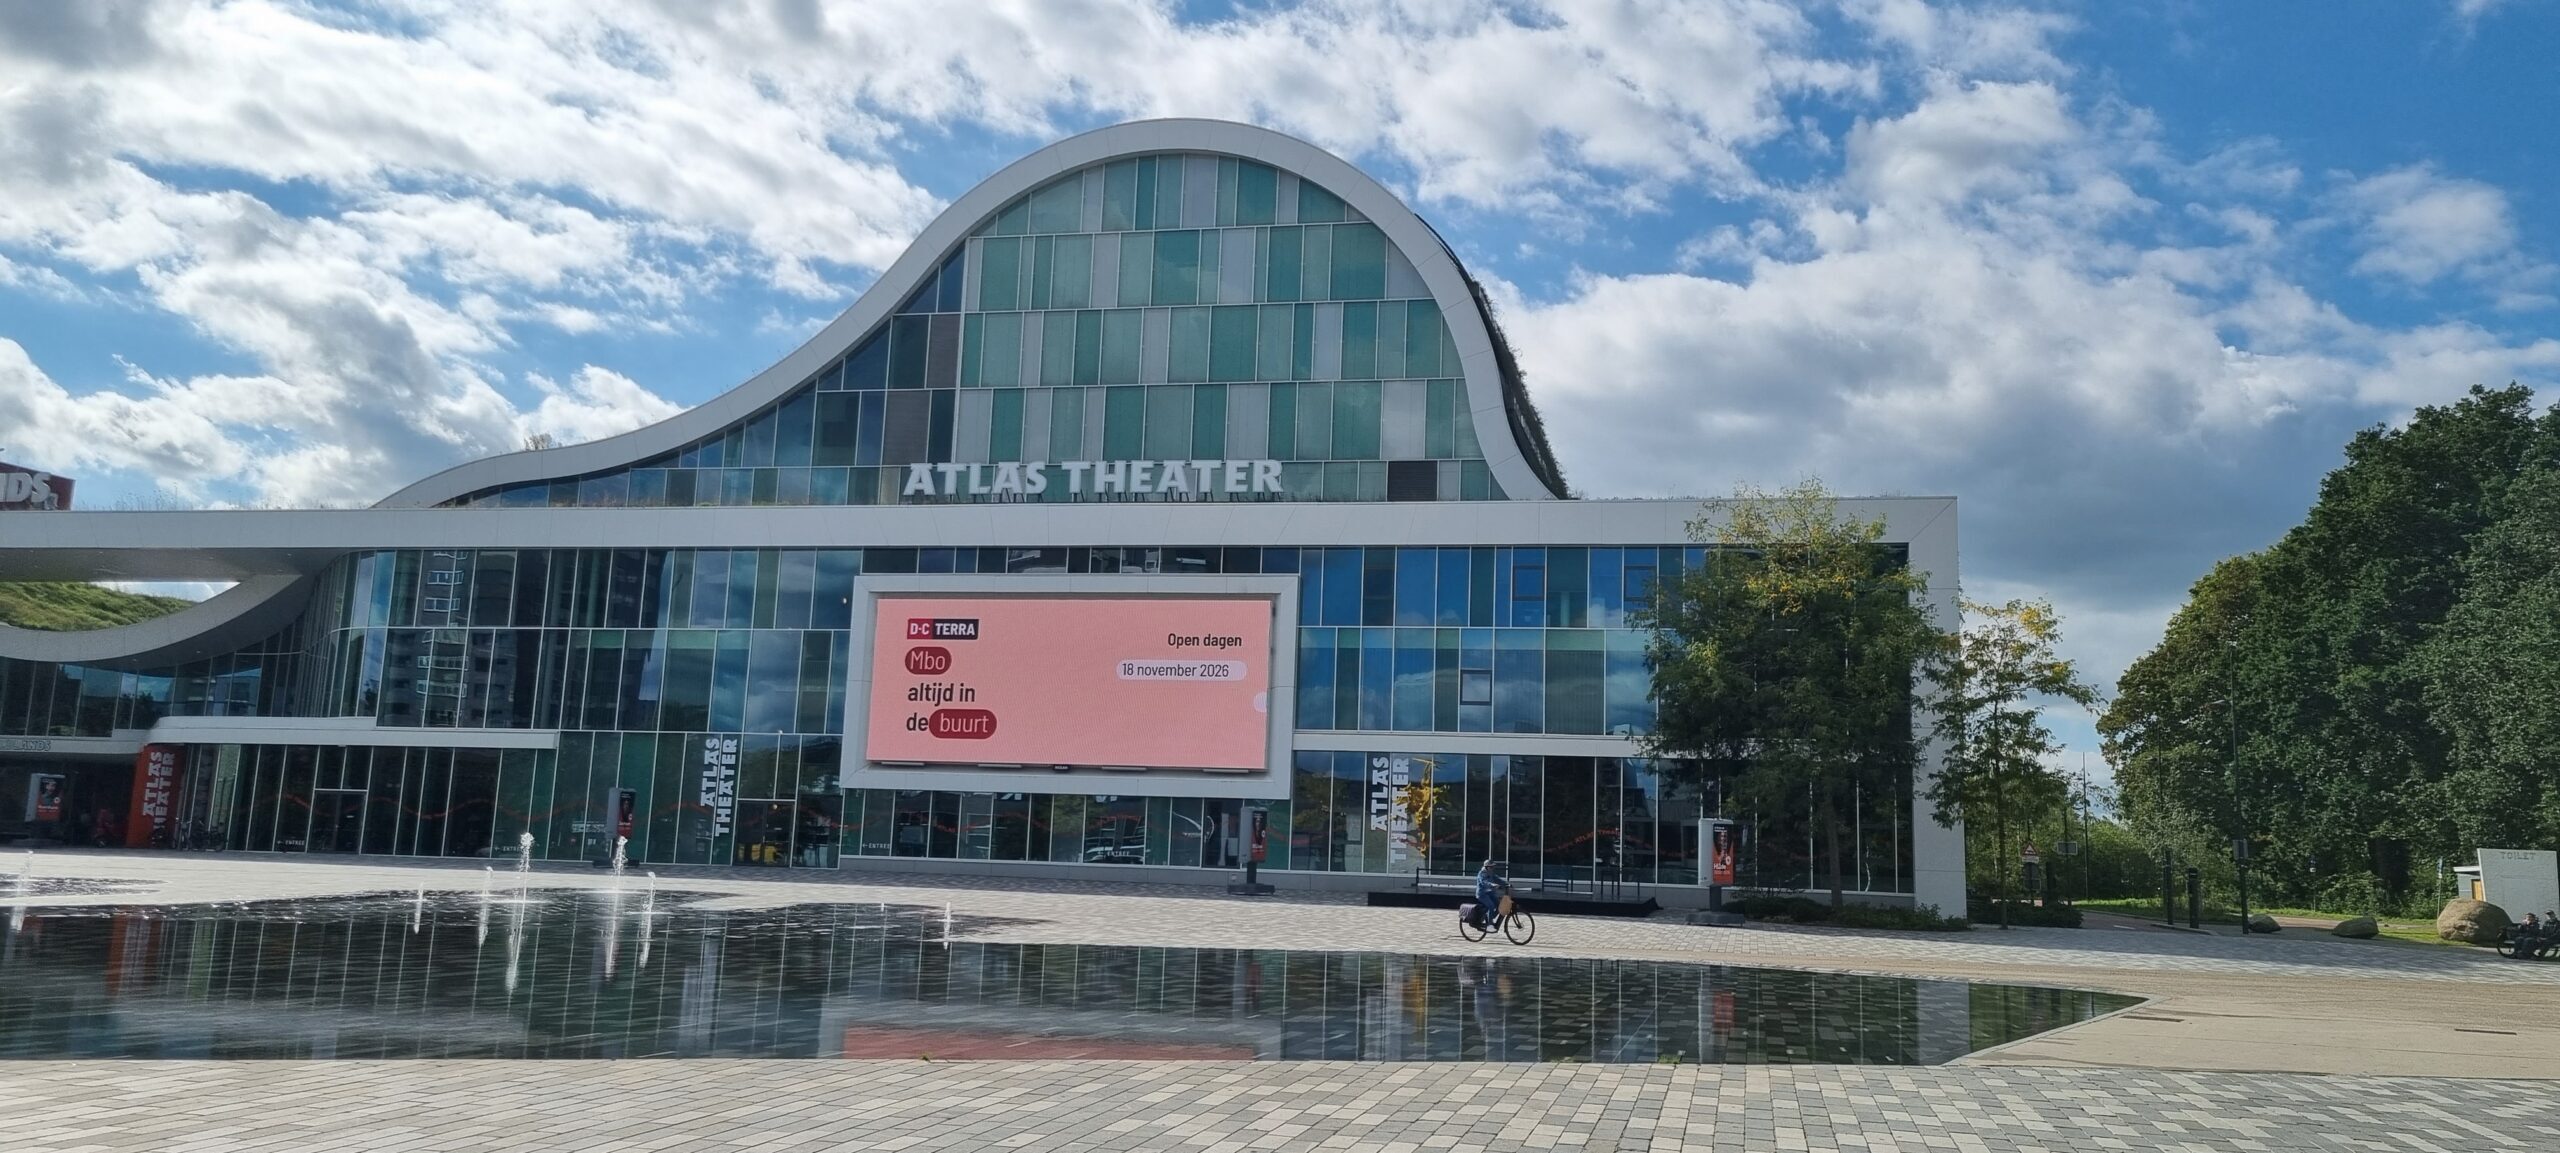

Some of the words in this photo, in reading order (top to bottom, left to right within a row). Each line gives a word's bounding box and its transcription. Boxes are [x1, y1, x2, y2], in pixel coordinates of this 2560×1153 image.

[903, 462, 1047, 496] ATLAS
[1061, 460, 1284, 493] THEATER
[935, 623, 975, 635] TERRA
[1168, 633, 1200, 649] Open
[1203, 634, 1242, 650] dagen
[910, 651, 946, 670] Mbo
[1122, 663, 1134, 676] 18
[1137, 664, 1197, 677] november
[1200, 664, 1229, 677] 2026
[908, 683, 954, 706] altijd
[960, 683, 975, 702] in
[906, 713, 929, 731] de
[940, 713, 989, 732] buurt
[142, 752, 163, 816] ATLAS
[700, 738, 720, 807] ATLAS
[715, 739, 738, 837] THEATER
[1371, 756, 1389, 831] ATLAS
[1390, 758, 1409, 864] THEATER
[2499, 851, 2536, 860] TOILET
